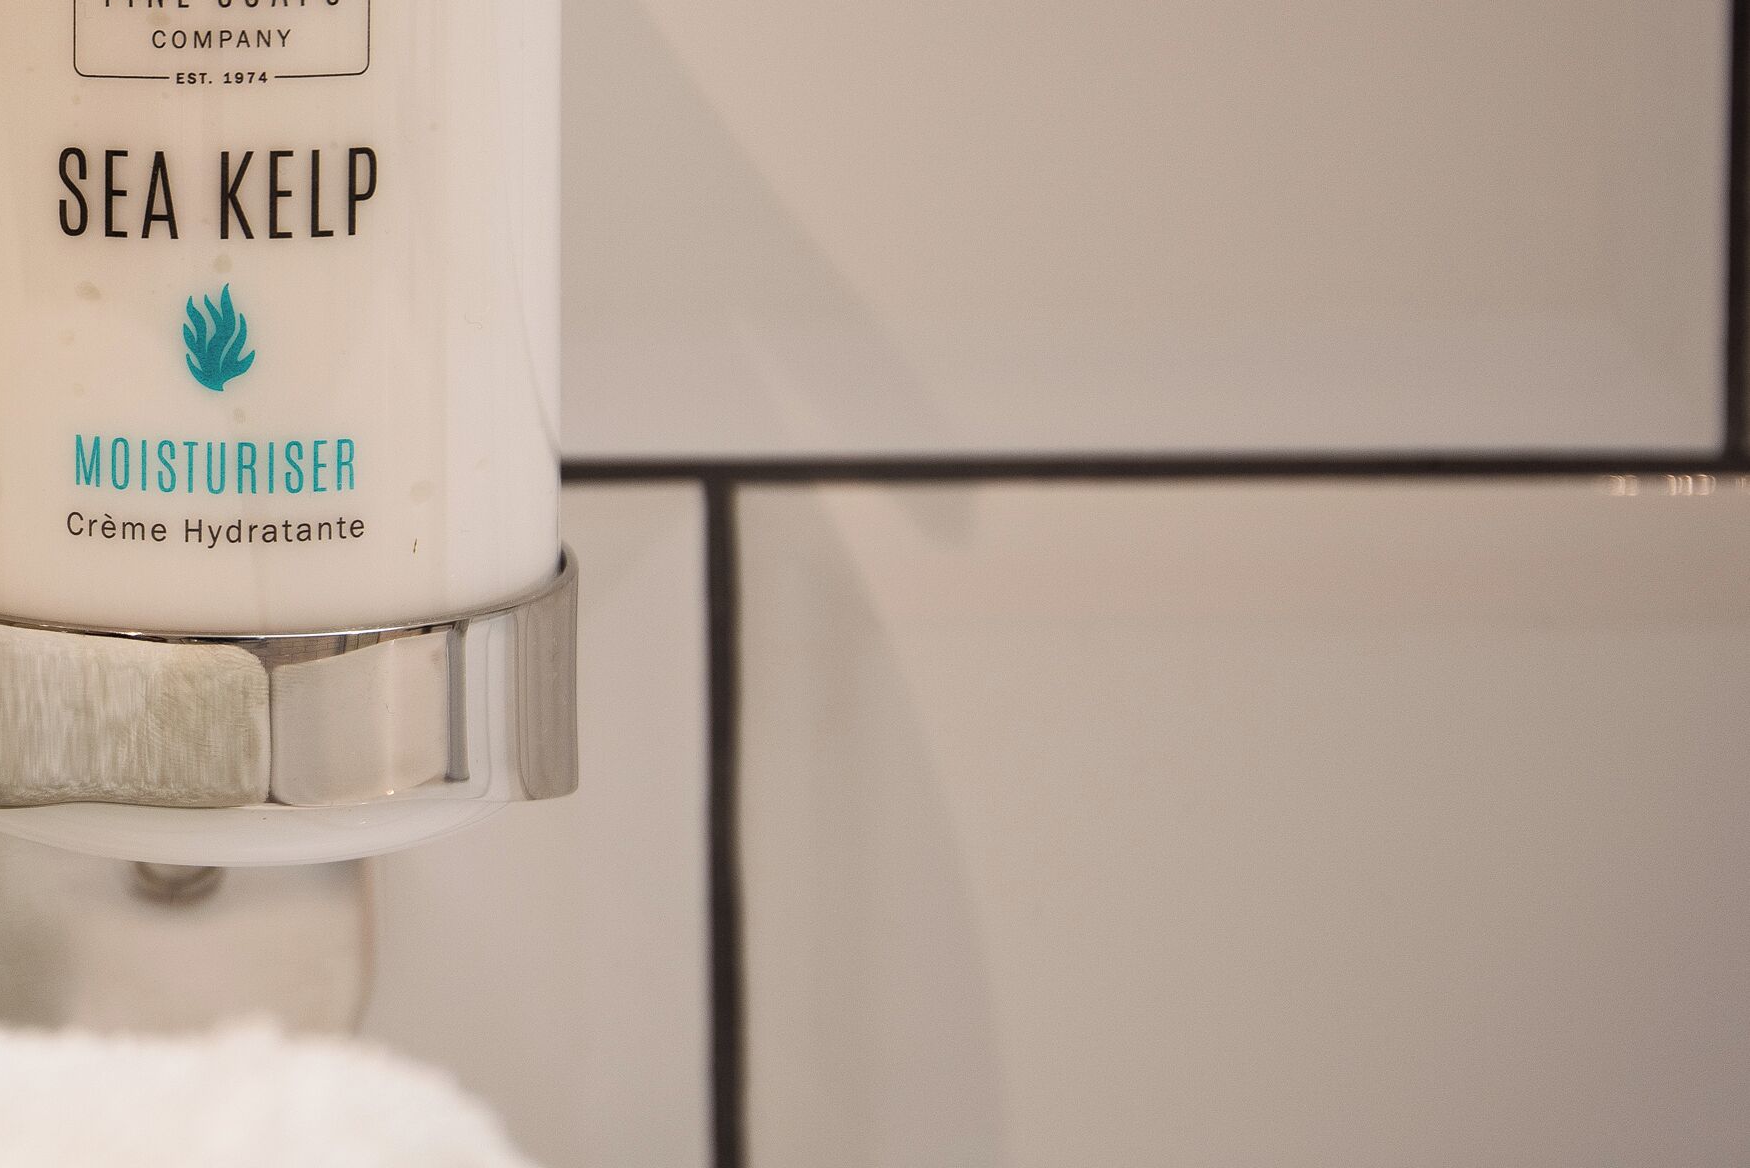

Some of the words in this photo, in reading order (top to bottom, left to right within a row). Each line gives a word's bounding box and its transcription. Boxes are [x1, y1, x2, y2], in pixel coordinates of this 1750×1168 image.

[152, 28, 292, 49] COMPANY
[175, 72, 213, 85] EST.
[223, 72, 269, 84] 1974
[58, 146, 179, 240] SEA
[220, 146, 378, 240] KELP
[75, 433, 356, 495] MOISTURISER
[66, 511, 168, 543] Crème
[184, 515, 365, 549] Hydratante
